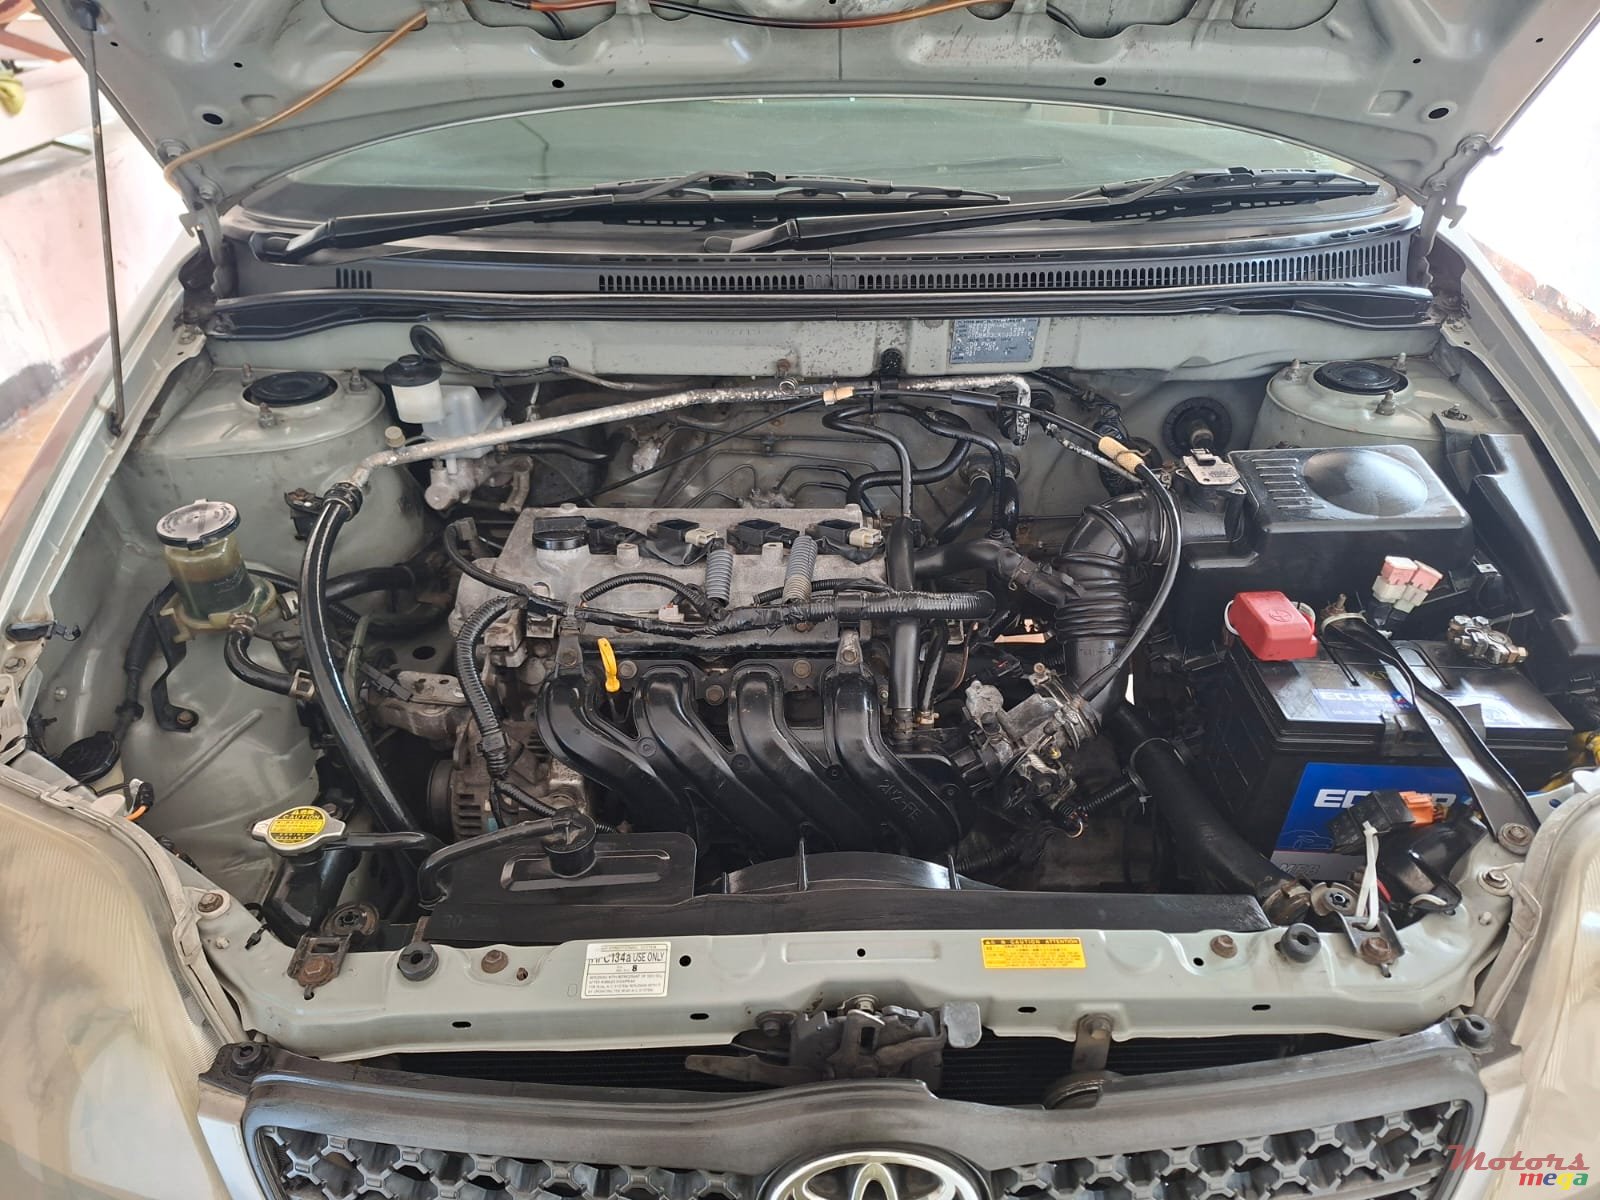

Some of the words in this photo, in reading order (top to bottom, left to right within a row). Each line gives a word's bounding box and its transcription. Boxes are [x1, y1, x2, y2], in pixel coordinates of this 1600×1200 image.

[633, 952, 646, 962] USE
[647, 951, 664, 961] ONLY
[632, 964, 638, 972] 8
